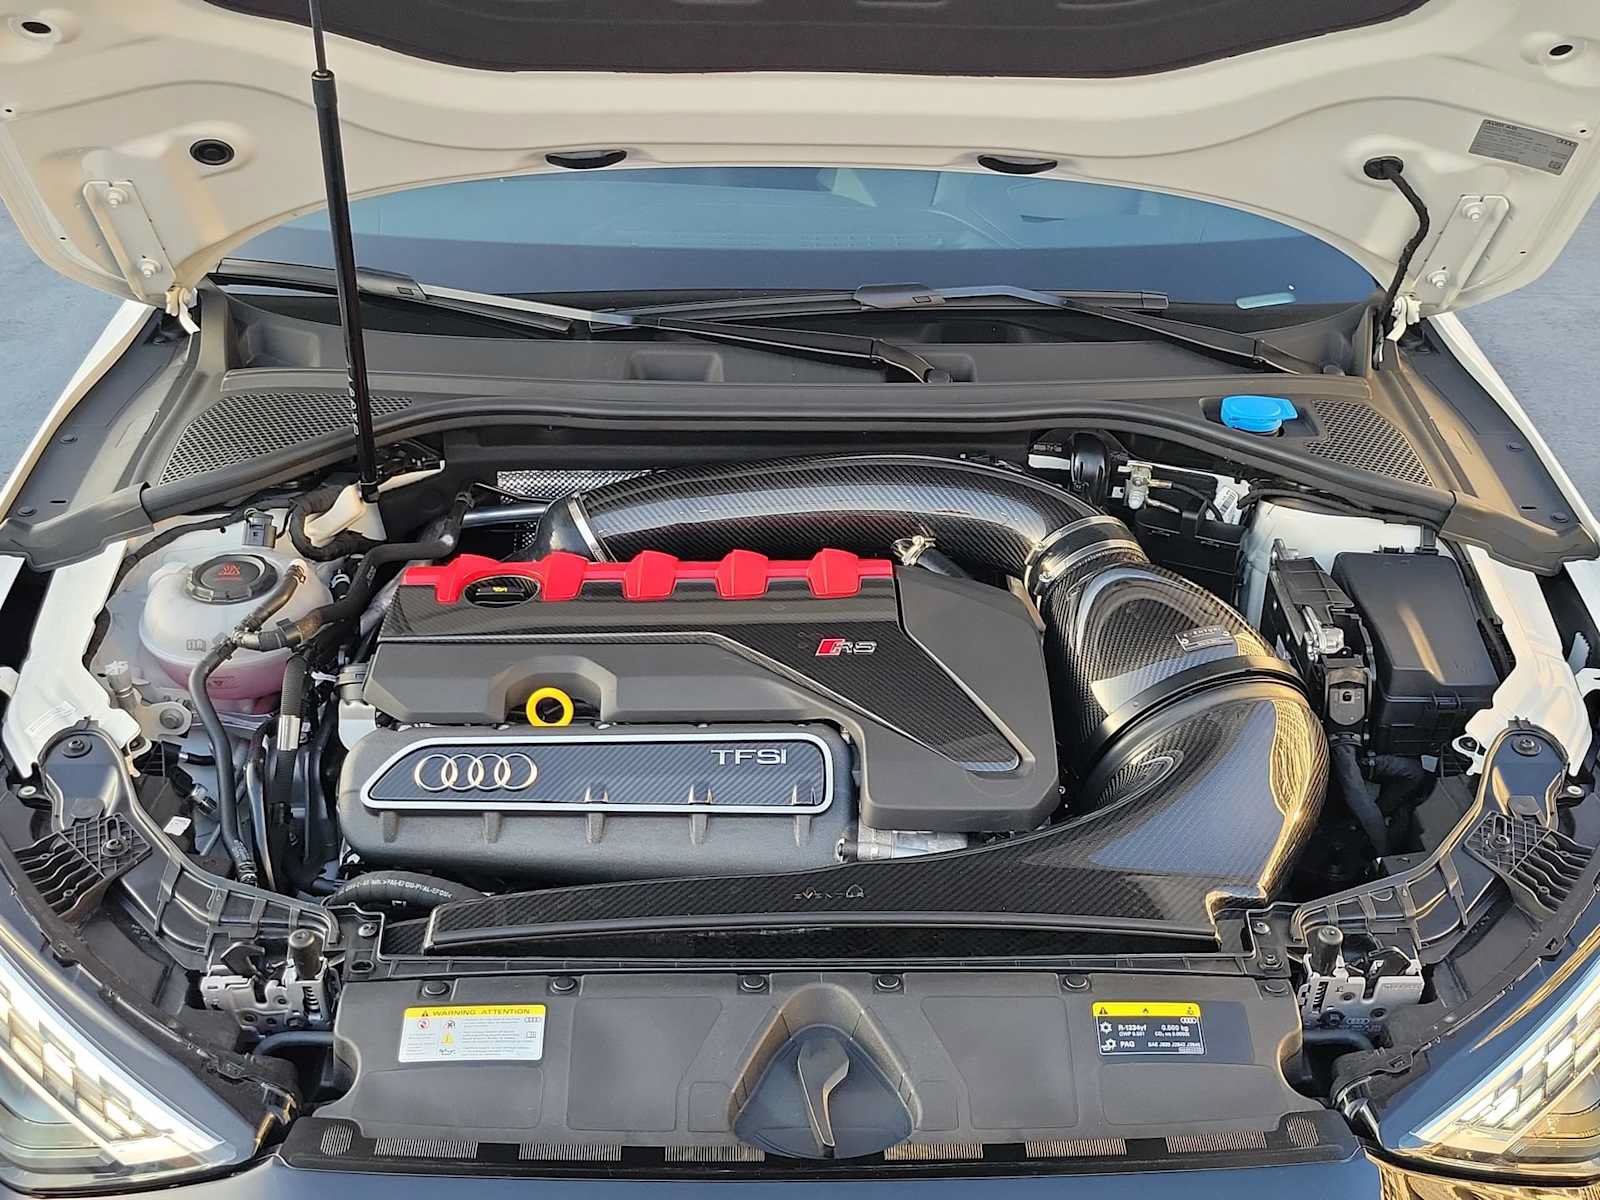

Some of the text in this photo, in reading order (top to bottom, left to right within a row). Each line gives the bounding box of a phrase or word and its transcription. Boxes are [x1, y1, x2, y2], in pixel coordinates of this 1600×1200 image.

[826, 640, 877, 656] RS
[710, 748, 787, 765] TFSI
[432, 1008, 530, 1017] WARNING ATTENTION
[1120, 1040, 1135, 1048] PAG
